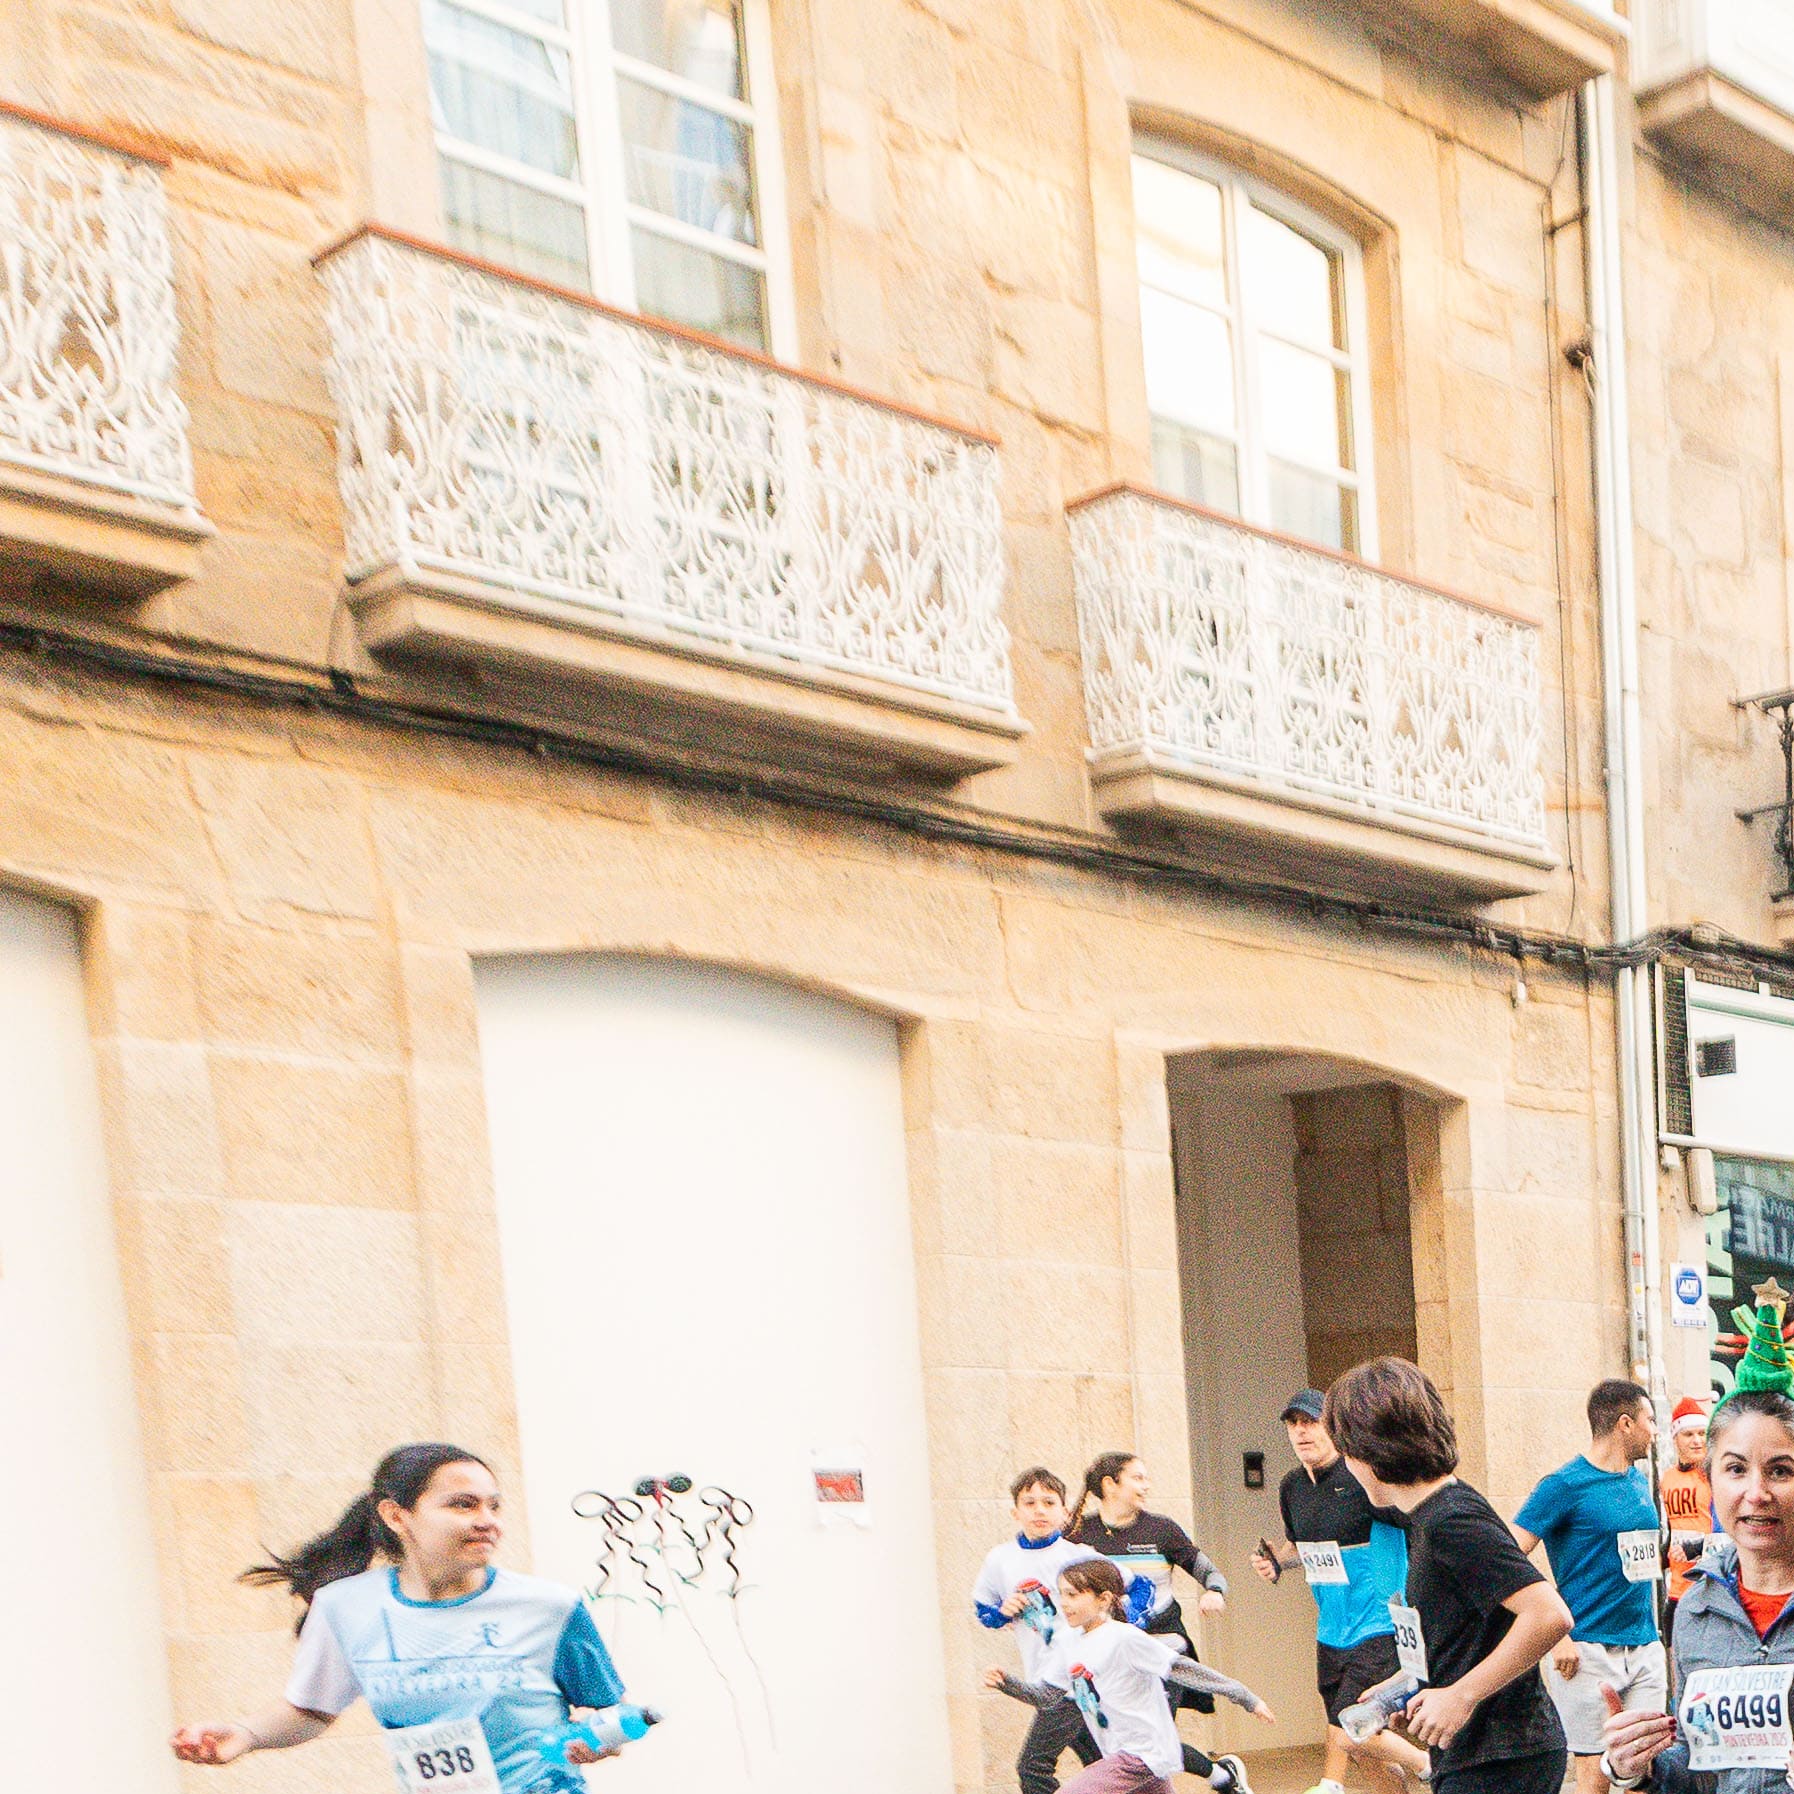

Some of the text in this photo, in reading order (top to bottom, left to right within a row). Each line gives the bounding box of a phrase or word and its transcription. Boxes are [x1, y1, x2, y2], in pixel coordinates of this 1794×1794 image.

[1313, 1554, 1339, 1567] 2491
[1632, 1543, 1656, 1561] 2818
[1717, 1693, 1782, 1730] 6499
[415, 1745, 475, 1780] 838
